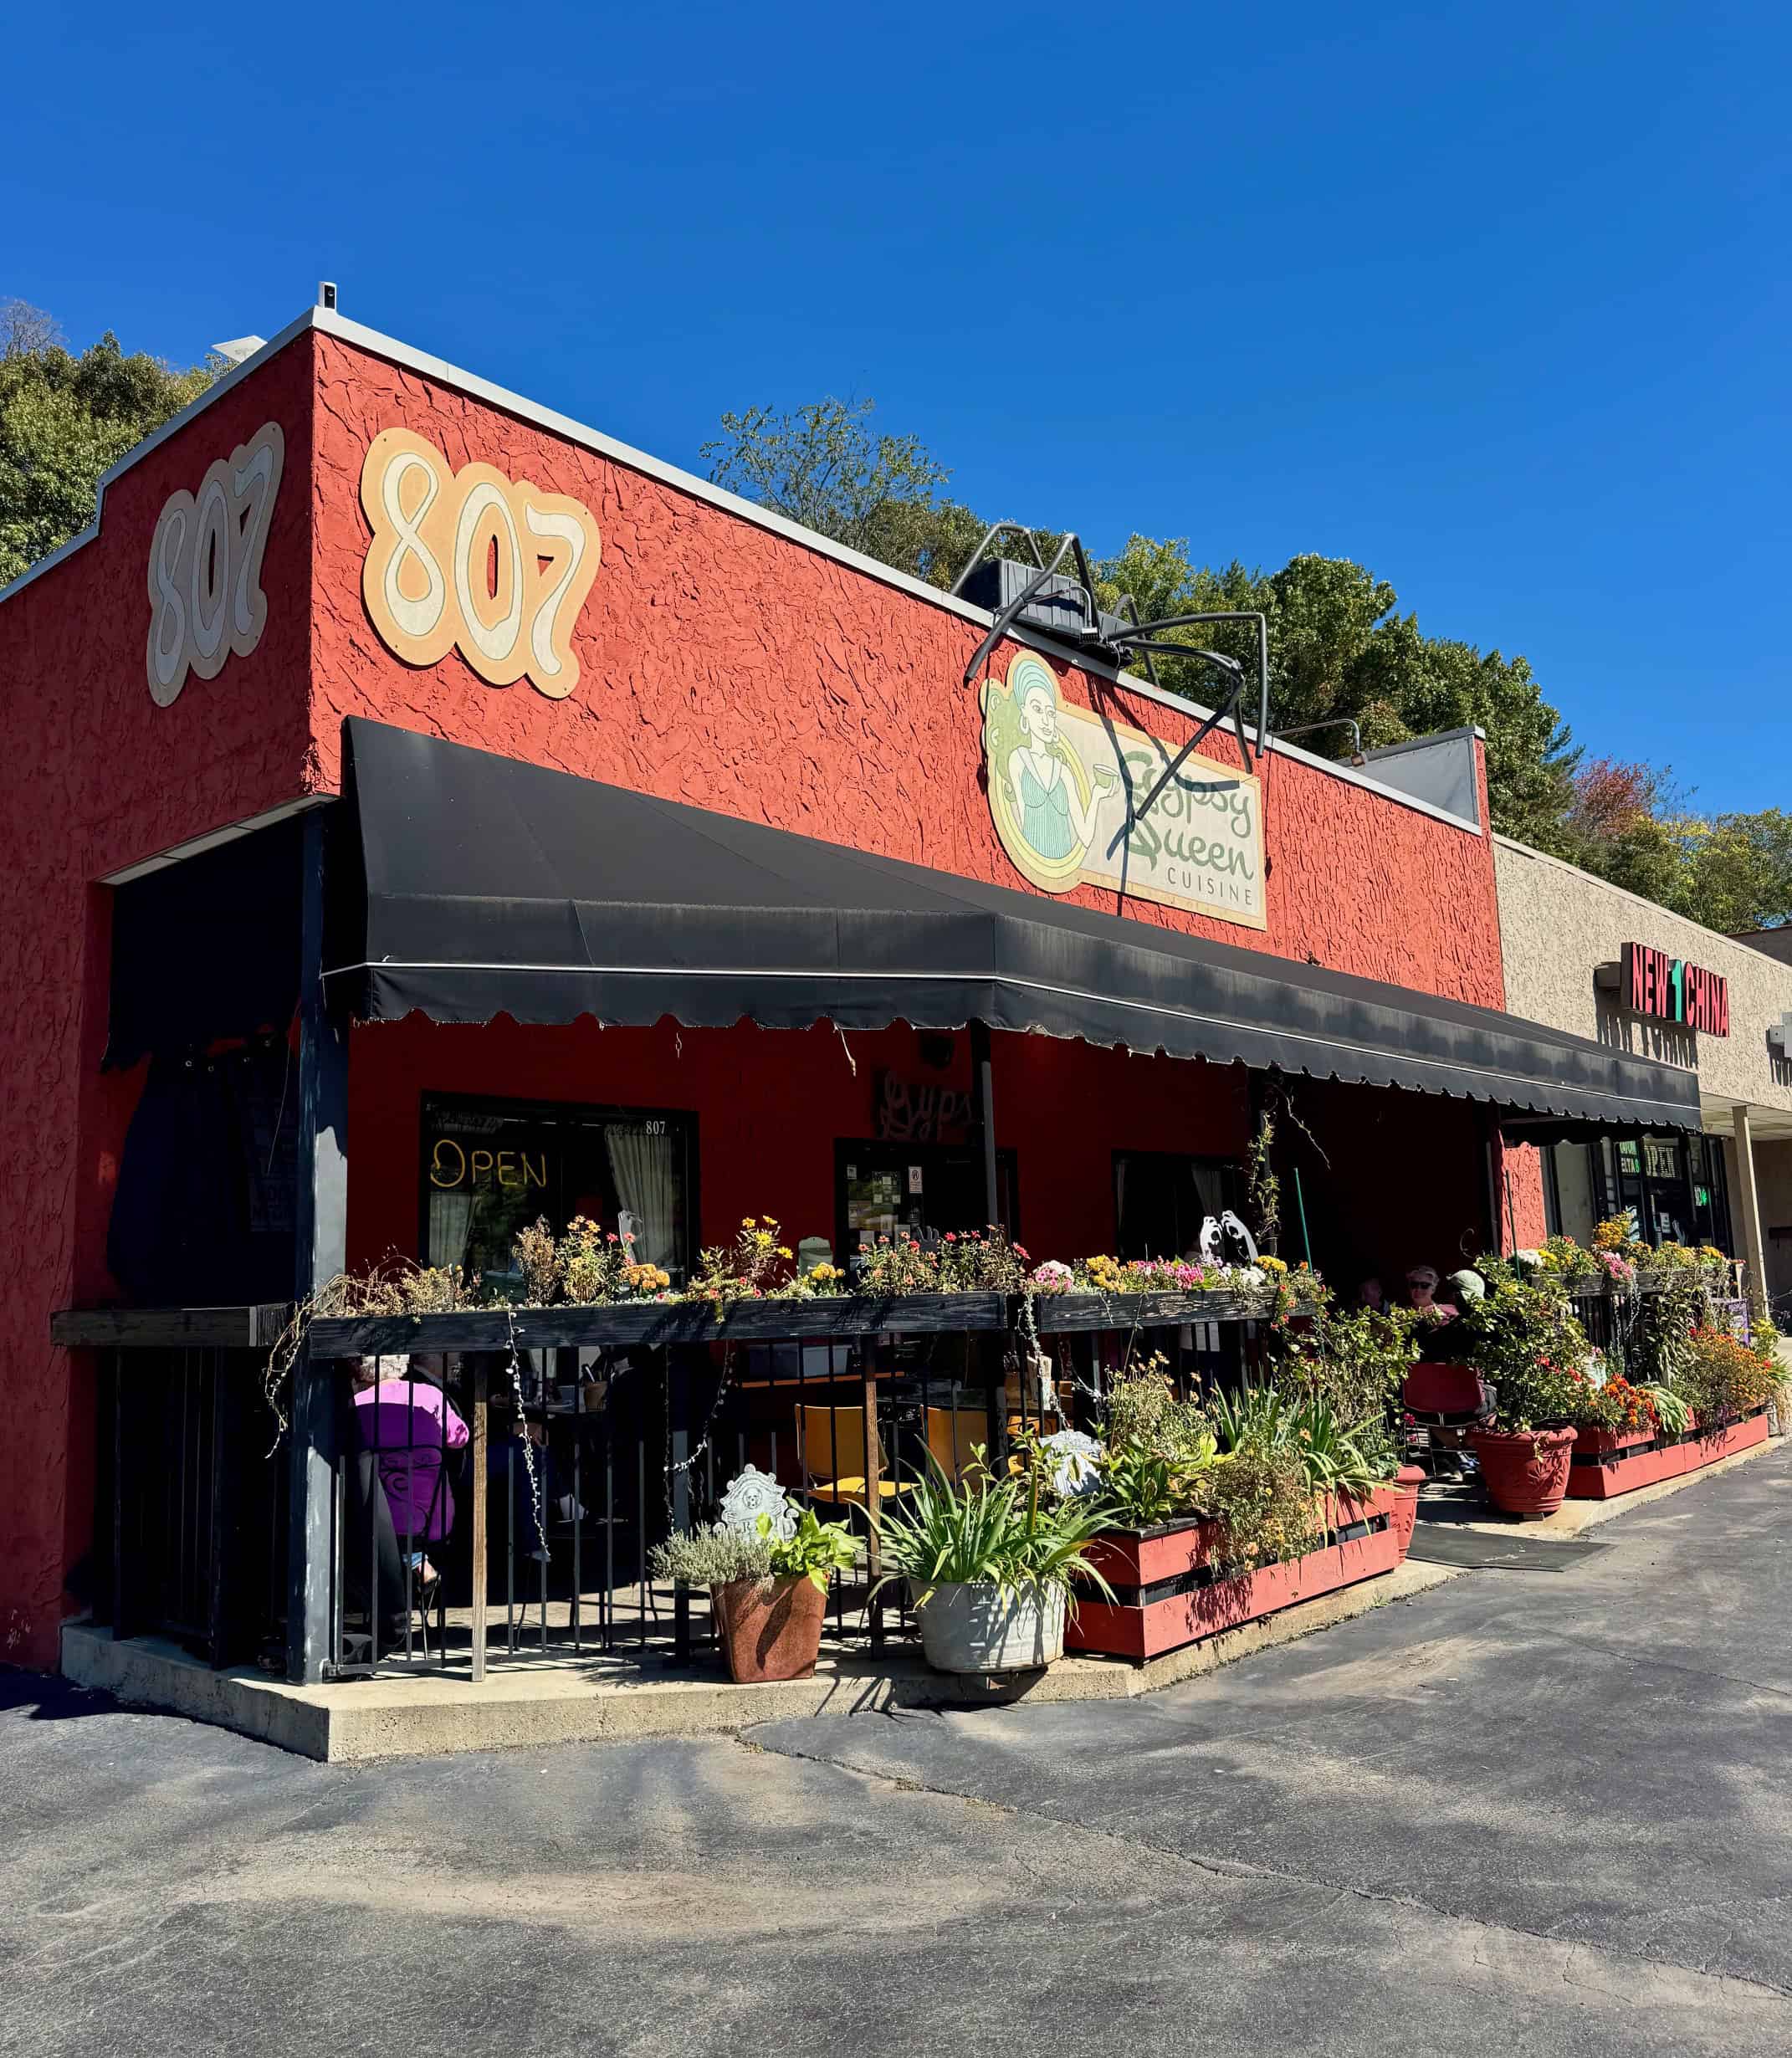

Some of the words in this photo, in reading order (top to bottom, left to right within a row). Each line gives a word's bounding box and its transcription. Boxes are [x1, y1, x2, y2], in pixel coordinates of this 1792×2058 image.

[154, 443, 274, 687] 807
[381, 451, 586, 676] 807
[1121, 750, 1252, 838] Gypsy
[1124, 813, 1255, 880] Queen
[1166, 867, 1252, 905] CUISINE
[1631, 941, 1669, 1018] NEW
[1669, 959, 1682, 1023] 1
[1684, 961, 1730, 1038] CHINA
[429, 1139, 547, 1188] OPEN
[645, 1120, 667, 1135] 807
